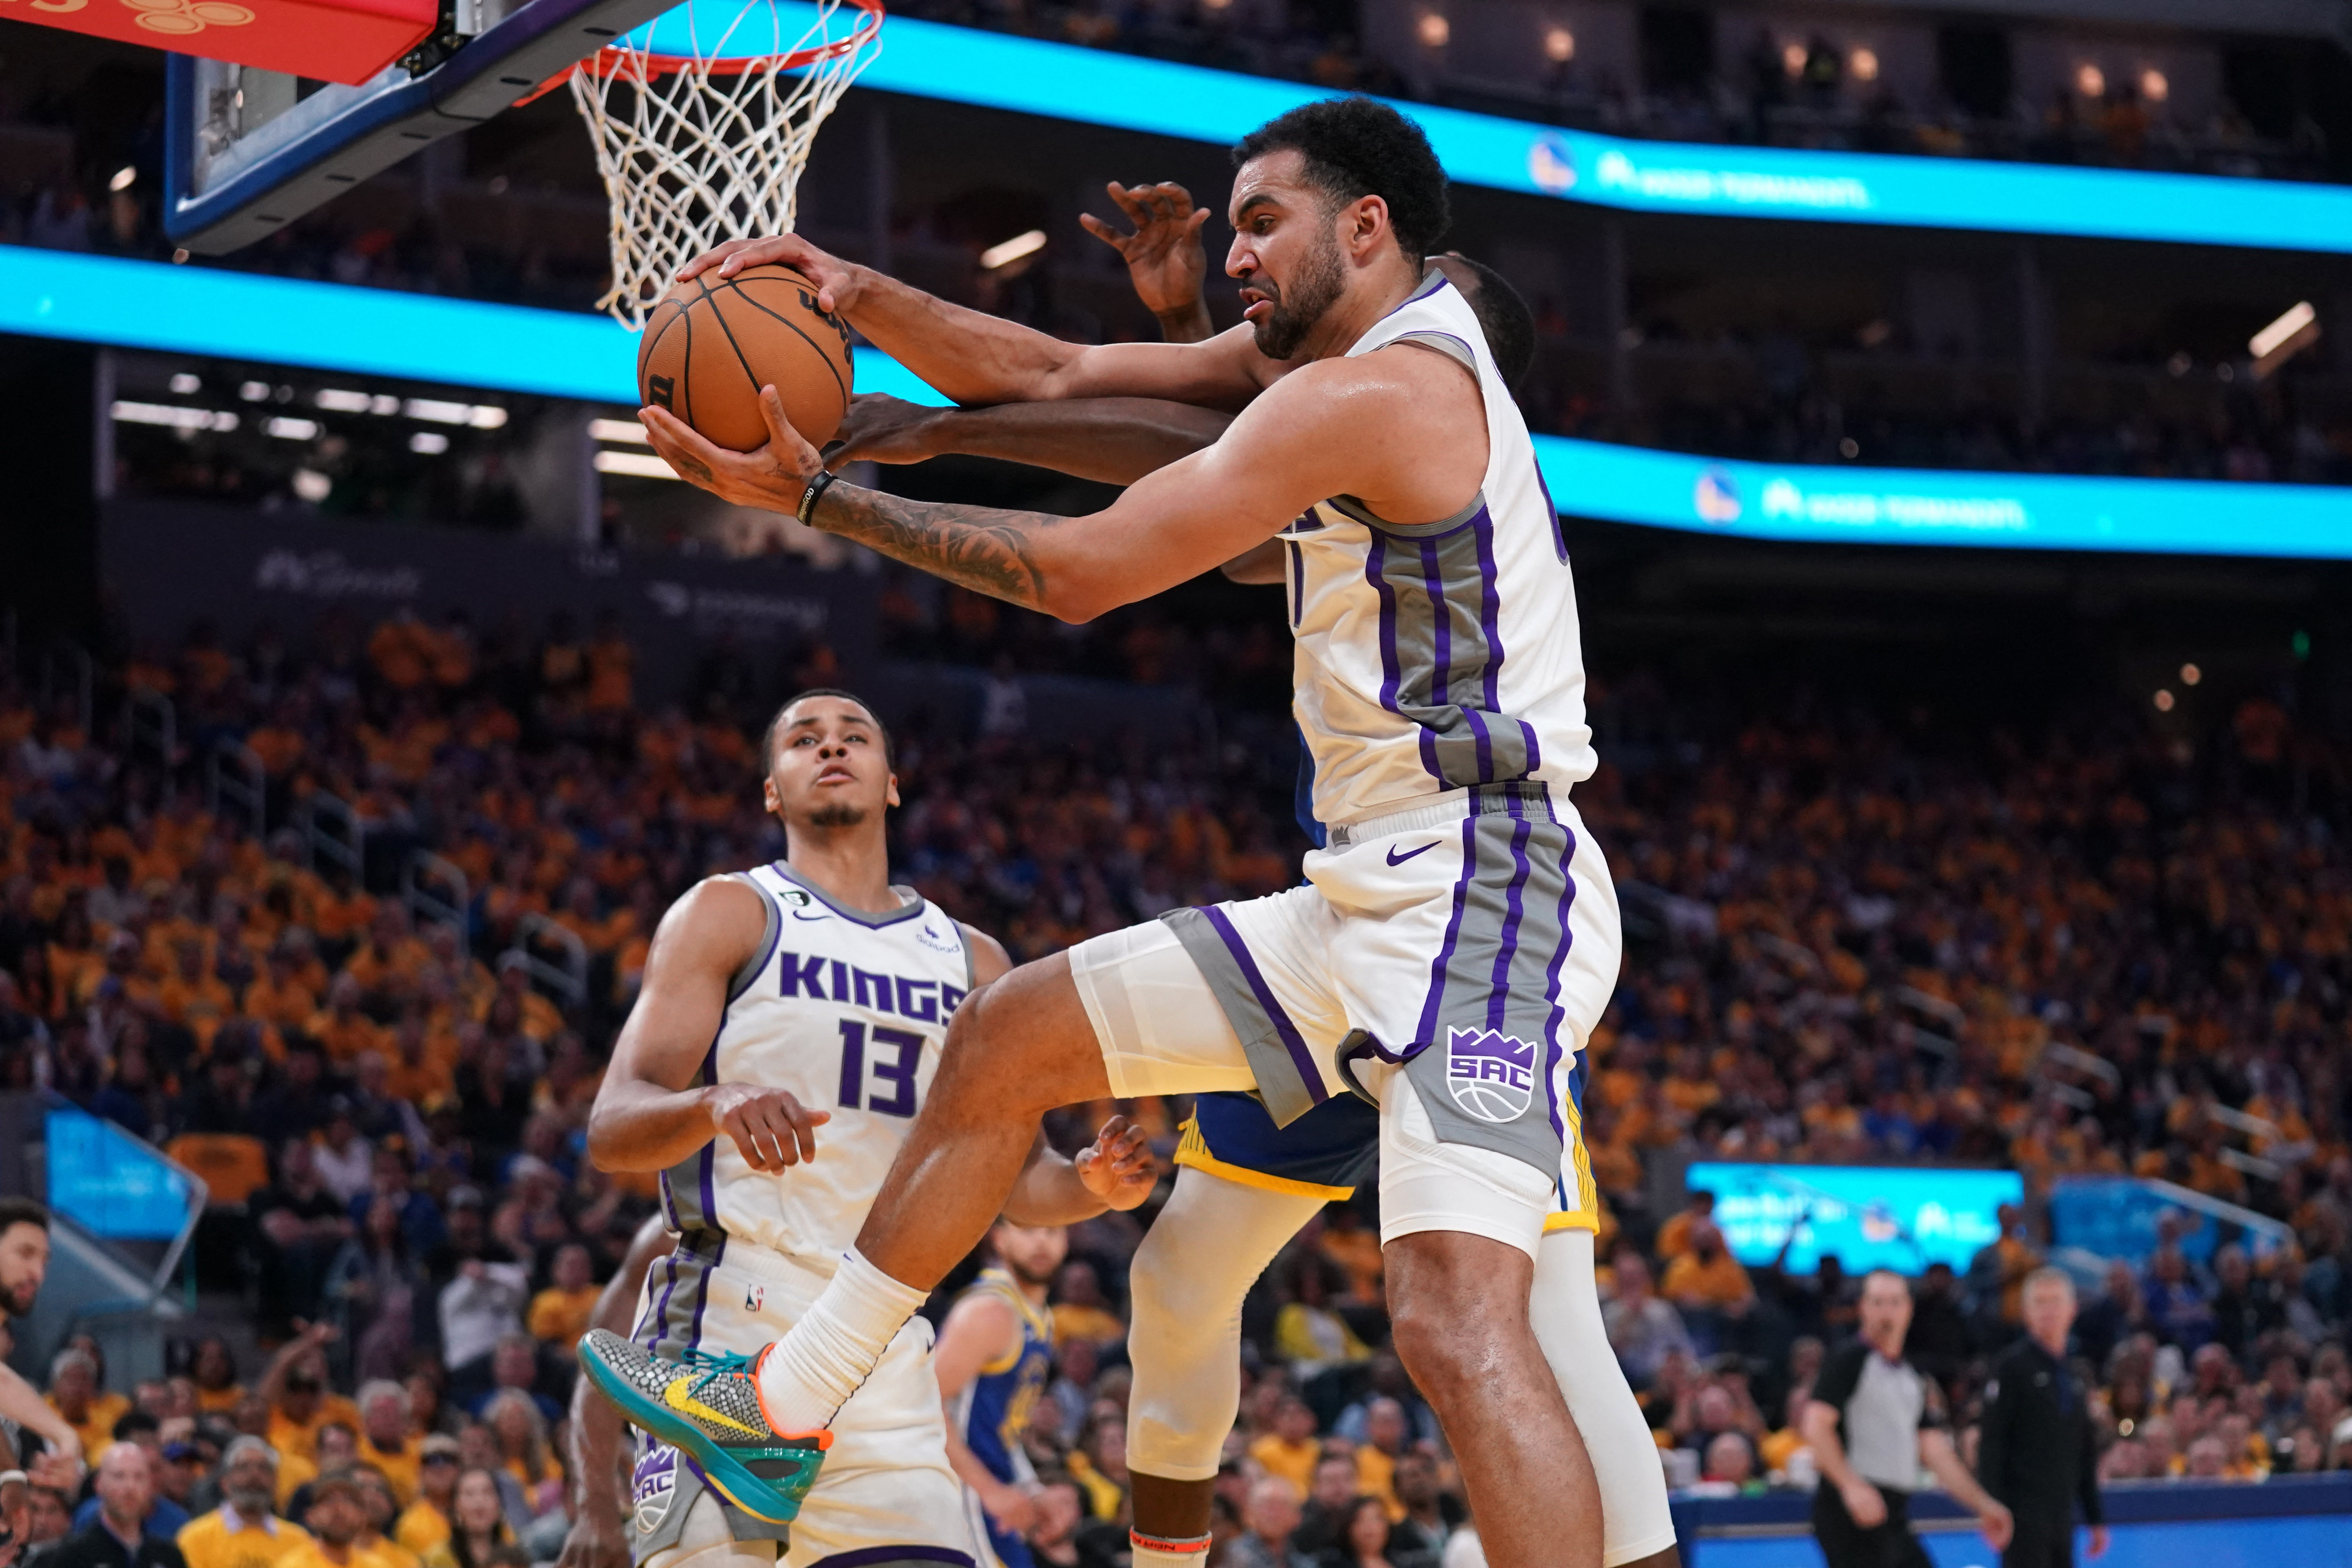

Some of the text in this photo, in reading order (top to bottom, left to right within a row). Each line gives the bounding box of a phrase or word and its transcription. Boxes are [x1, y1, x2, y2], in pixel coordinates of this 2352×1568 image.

[917, 933, 960, 953] dialpad
[780, 951, 967, 1028] KINGS
[838, 1018, 927, 1119] 13
[1450, 1058, 1531, 1091] SAC
